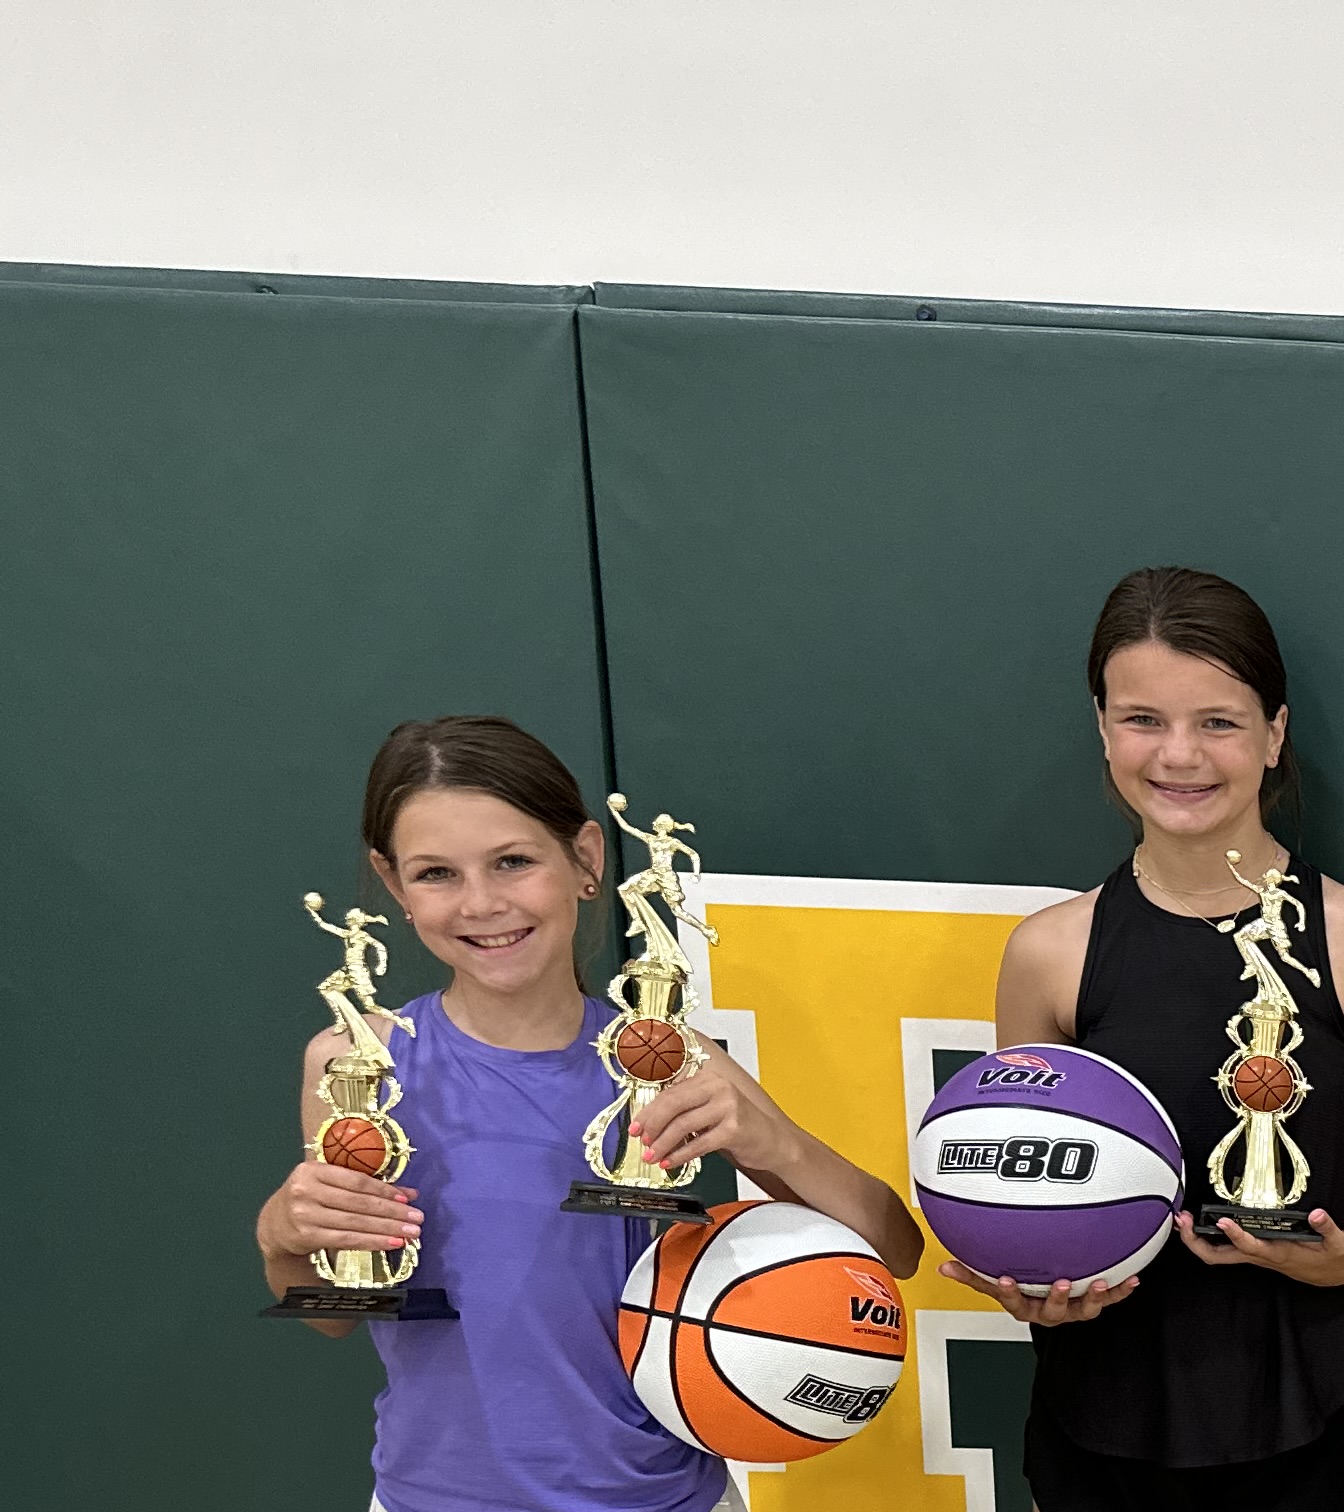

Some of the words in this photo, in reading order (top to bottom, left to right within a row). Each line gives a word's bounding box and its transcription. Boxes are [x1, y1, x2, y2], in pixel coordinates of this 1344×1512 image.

[977, 1067, 1067, 1089] Voit
[943, 1146, 999, 1169] LITE
[999, 1138, 1097, 1182] 80
[850, 1296, 900, 1330] Voit
[798, 1379, 862, 1414] LITE
[844, 1384, 896, 1423] 8
